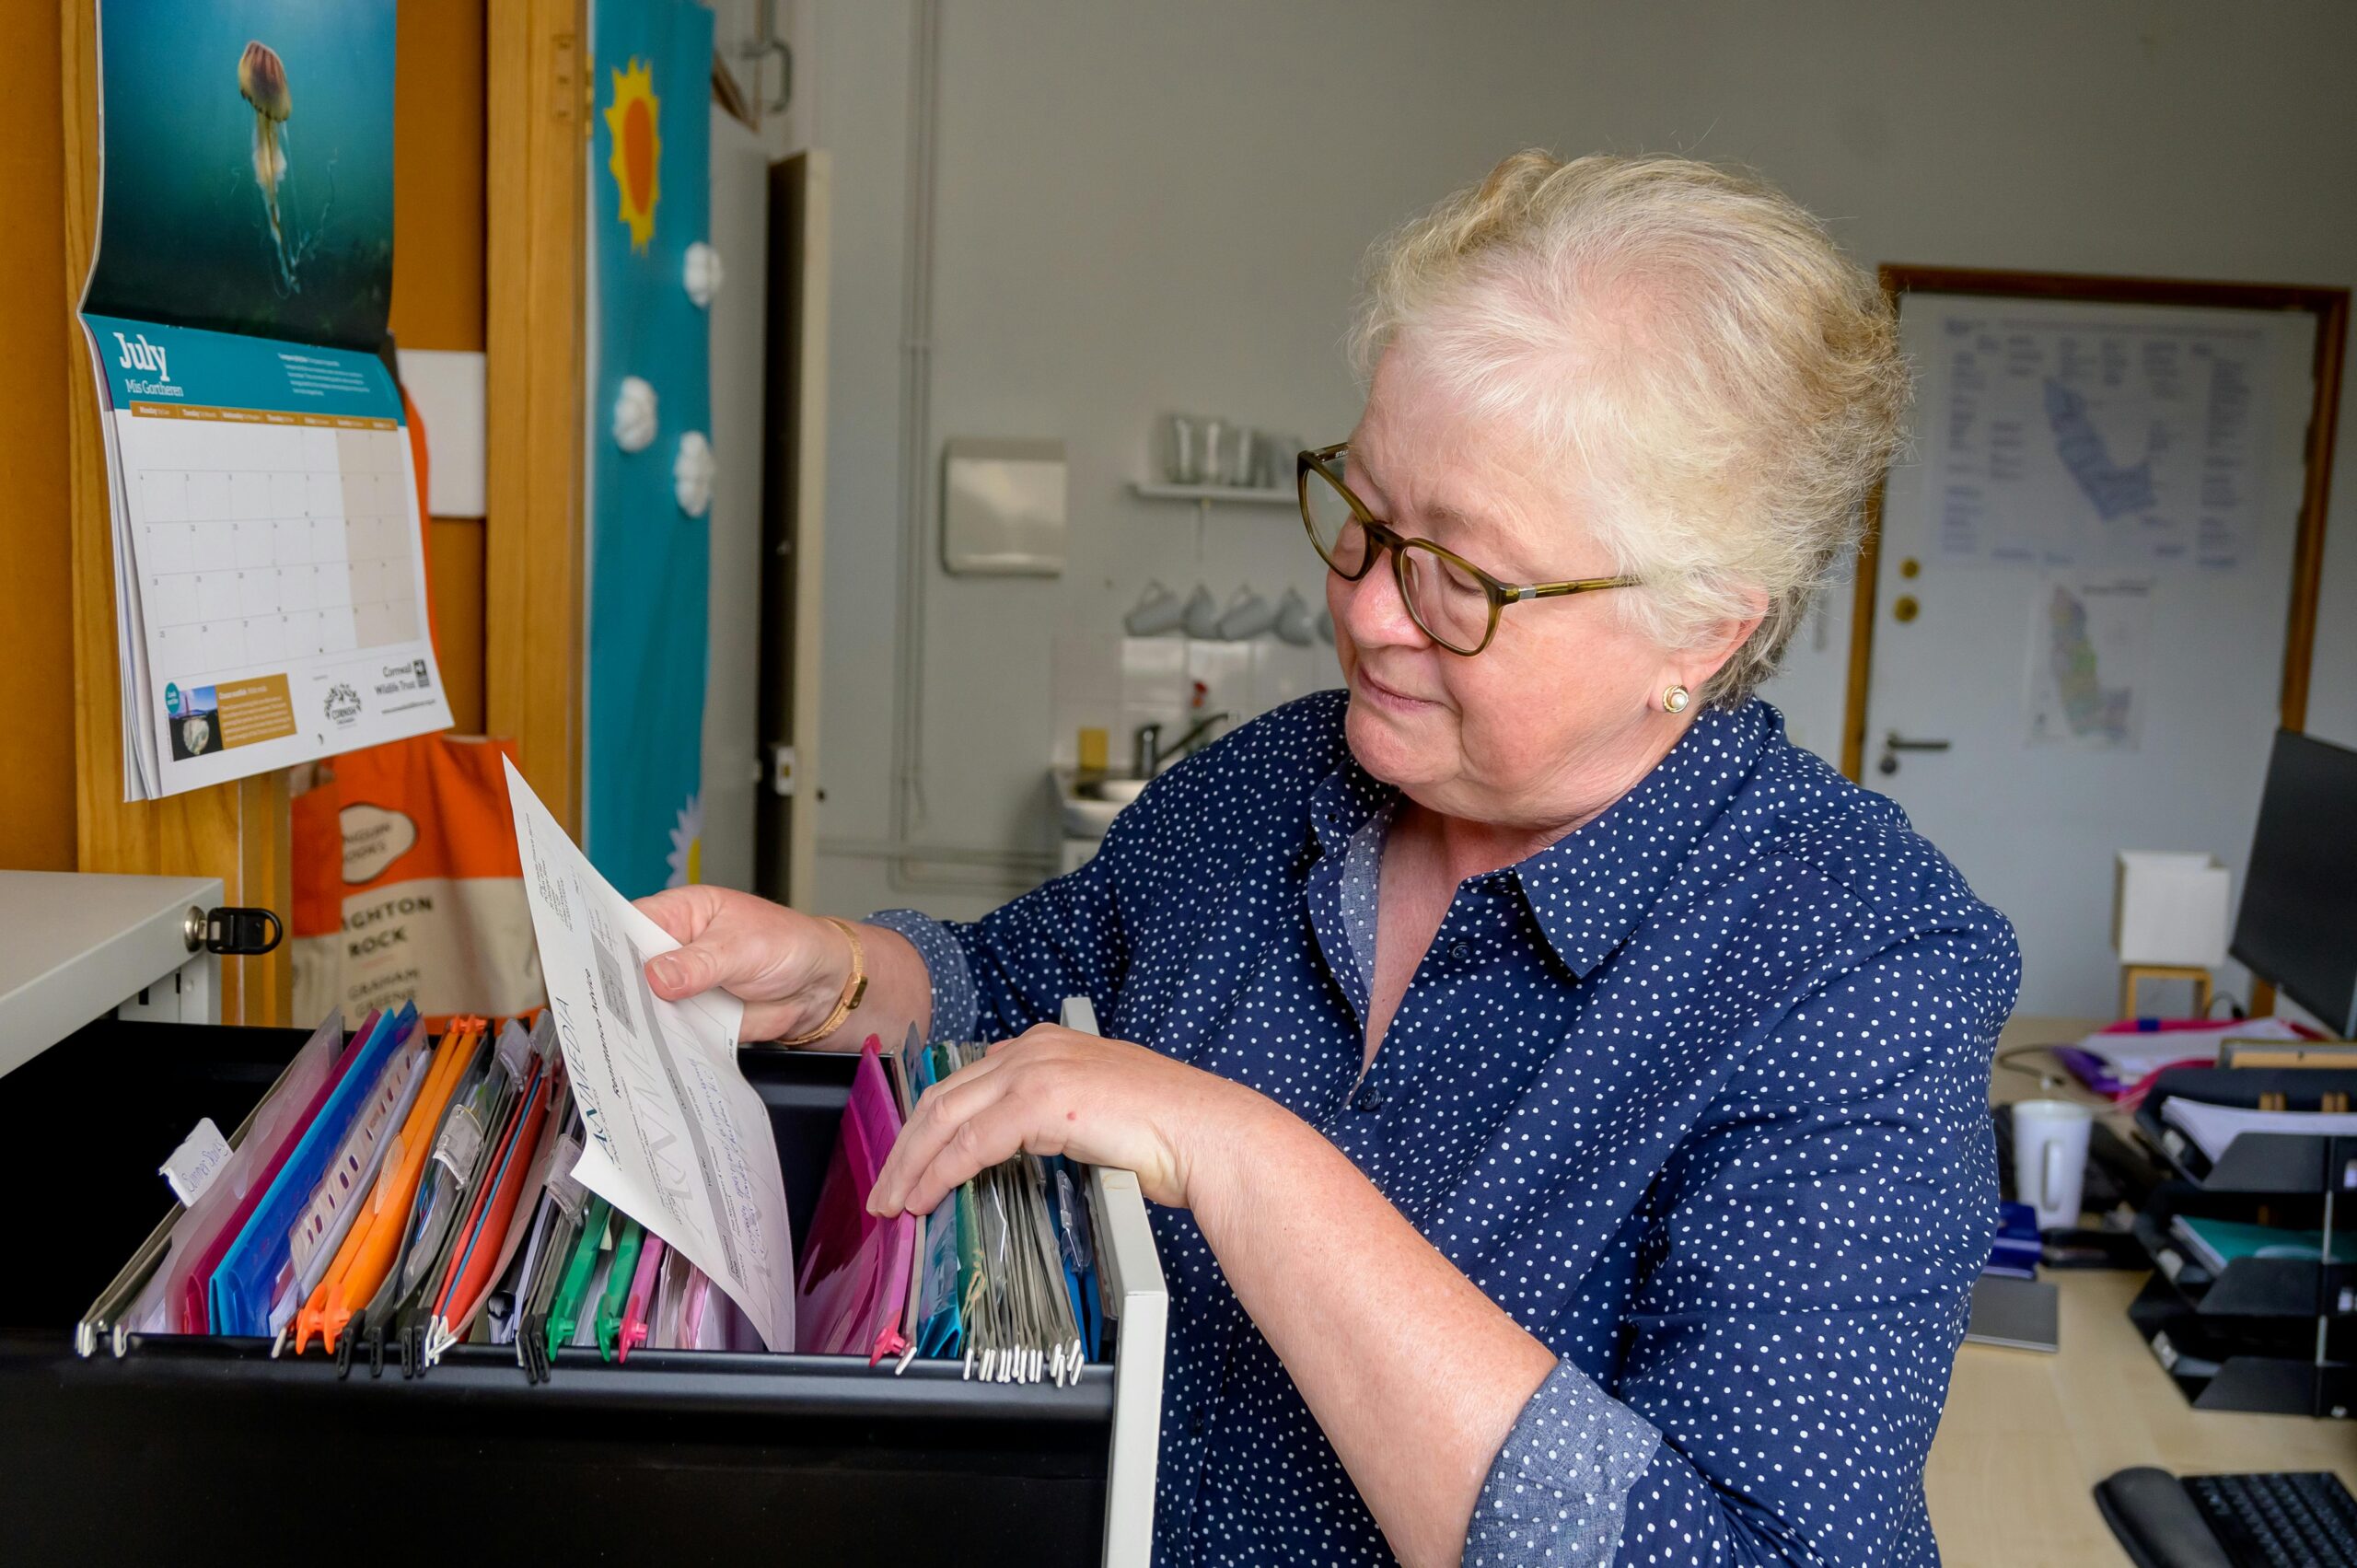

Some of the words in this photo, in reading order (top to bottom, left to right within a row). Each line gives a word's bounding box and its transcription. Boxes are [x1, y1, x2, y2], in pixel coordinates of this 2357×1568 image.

[112, 331, 170, 382] July
[382, 662, 412, 678] Cornwall
[348, 926, 408, 958] ROCK
[348, 969, 420, 1003] GRAHAM
[585, 969, 599, 1016] Advice
[597, 1018, 621, 1098] Remittance
